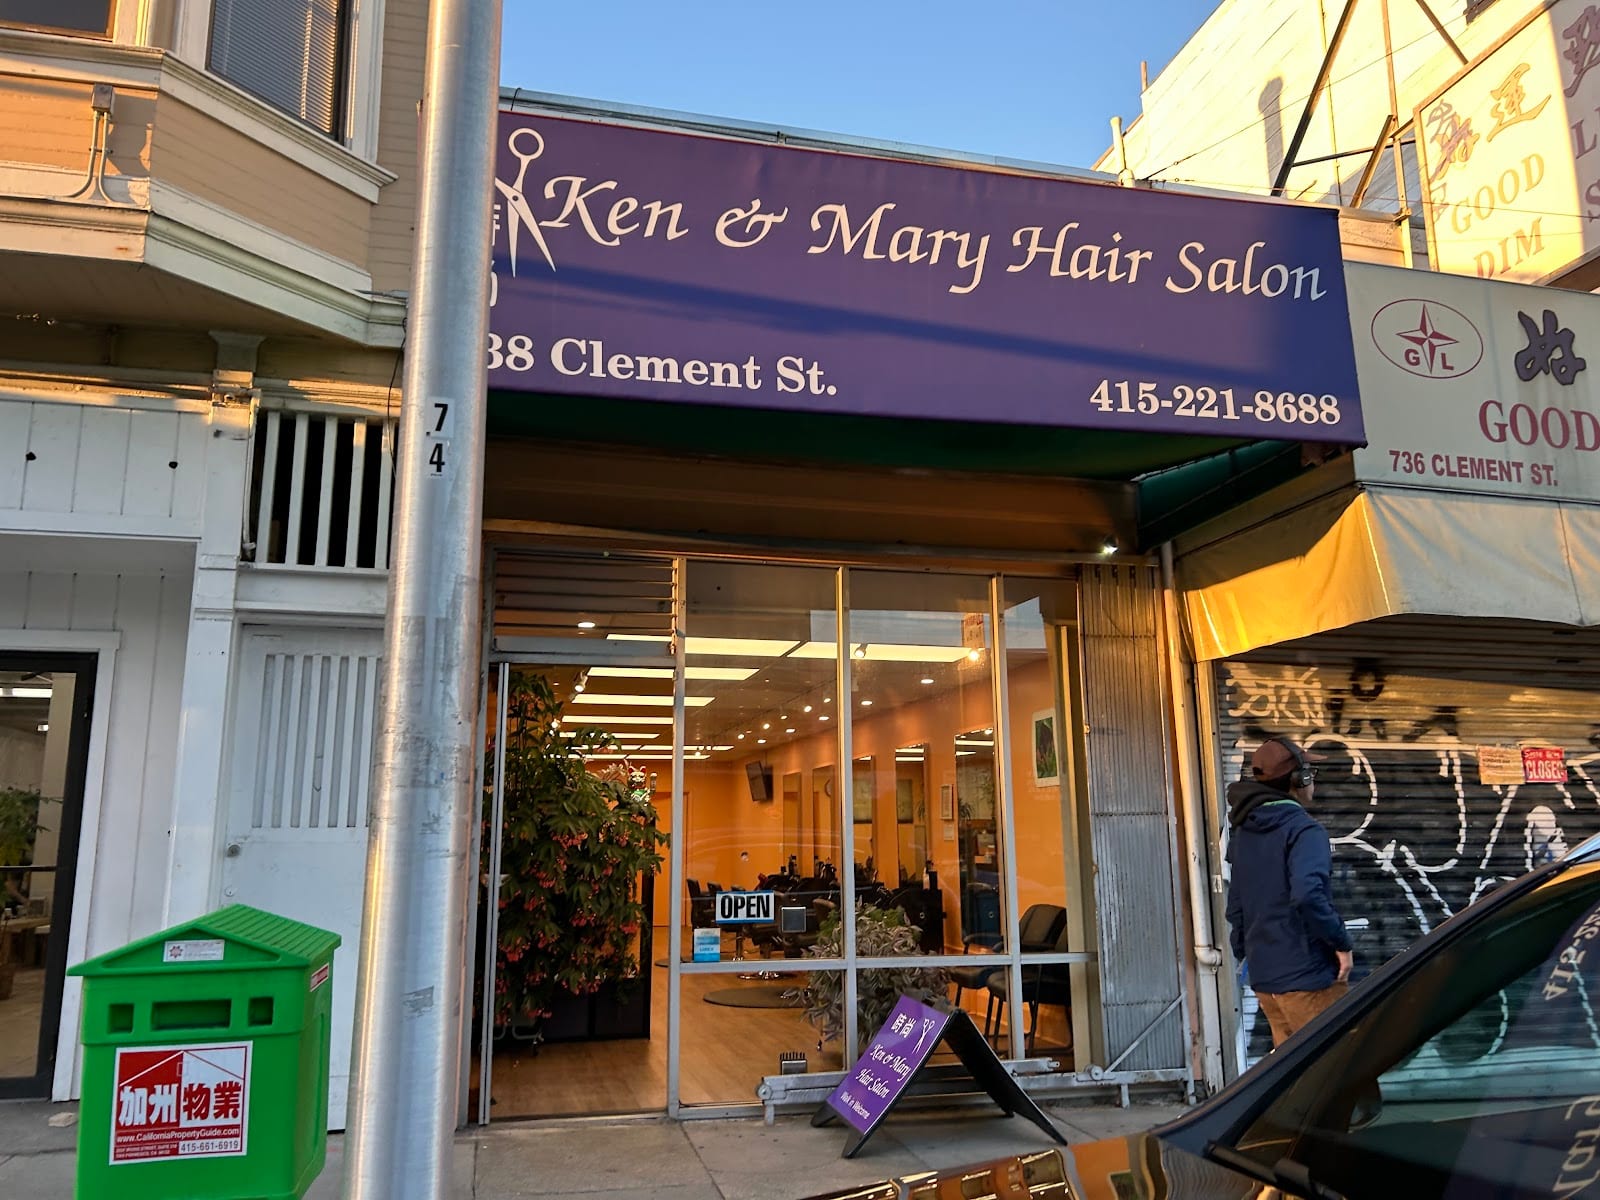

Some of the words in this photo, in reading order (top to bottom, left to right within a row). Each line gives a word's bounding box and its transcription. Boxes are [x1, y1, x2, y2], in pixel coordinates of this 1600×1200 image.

[1451, 153, 1545, 234] GOOD
[539, 175, 689, 247] Ken
[715, 198, 789, 248] &
[807, 201, 991, 295] Mary
[1006, 221, 1153, 284] Hair
[1165, 240, 1327, 301] Salon
[1473, 216, 1545, 280] DIM
[487, 332, 535, 372] 38
[550, 337, 762, 390] Clement
[776, 354, 837, 395] St.
[1404, 348, 1421, 367] G
[1441, 352, 1455, 371] L
[1089, 379, 1341, 425] 415-221-8688
[1478, 399, 1600, 452] GOOD
[1389, 450, 1425, 475] 736
[1431, 453, 1524, 483] CLEMENT
[1530, 463, 1559, 487] ST.
[720, 894, 770, 919] OPEN
[890, 1013, 917, 1039] 時尚
[870, 1044, 886, 1061] Ken
[883, 1053, 895, 1064] &
[889, 1055, 912, 1082] Mary
[856, 1068, 874, 1086] Hair
[868, 1078, 890, 1099] Salon
[119, 1081, 242, 1126] 加州物業
[116, 1128, 239, 1143] www.CaliforniaPropertyGuide.com
[180, 1140, 239, 1153] 415-661-6919
